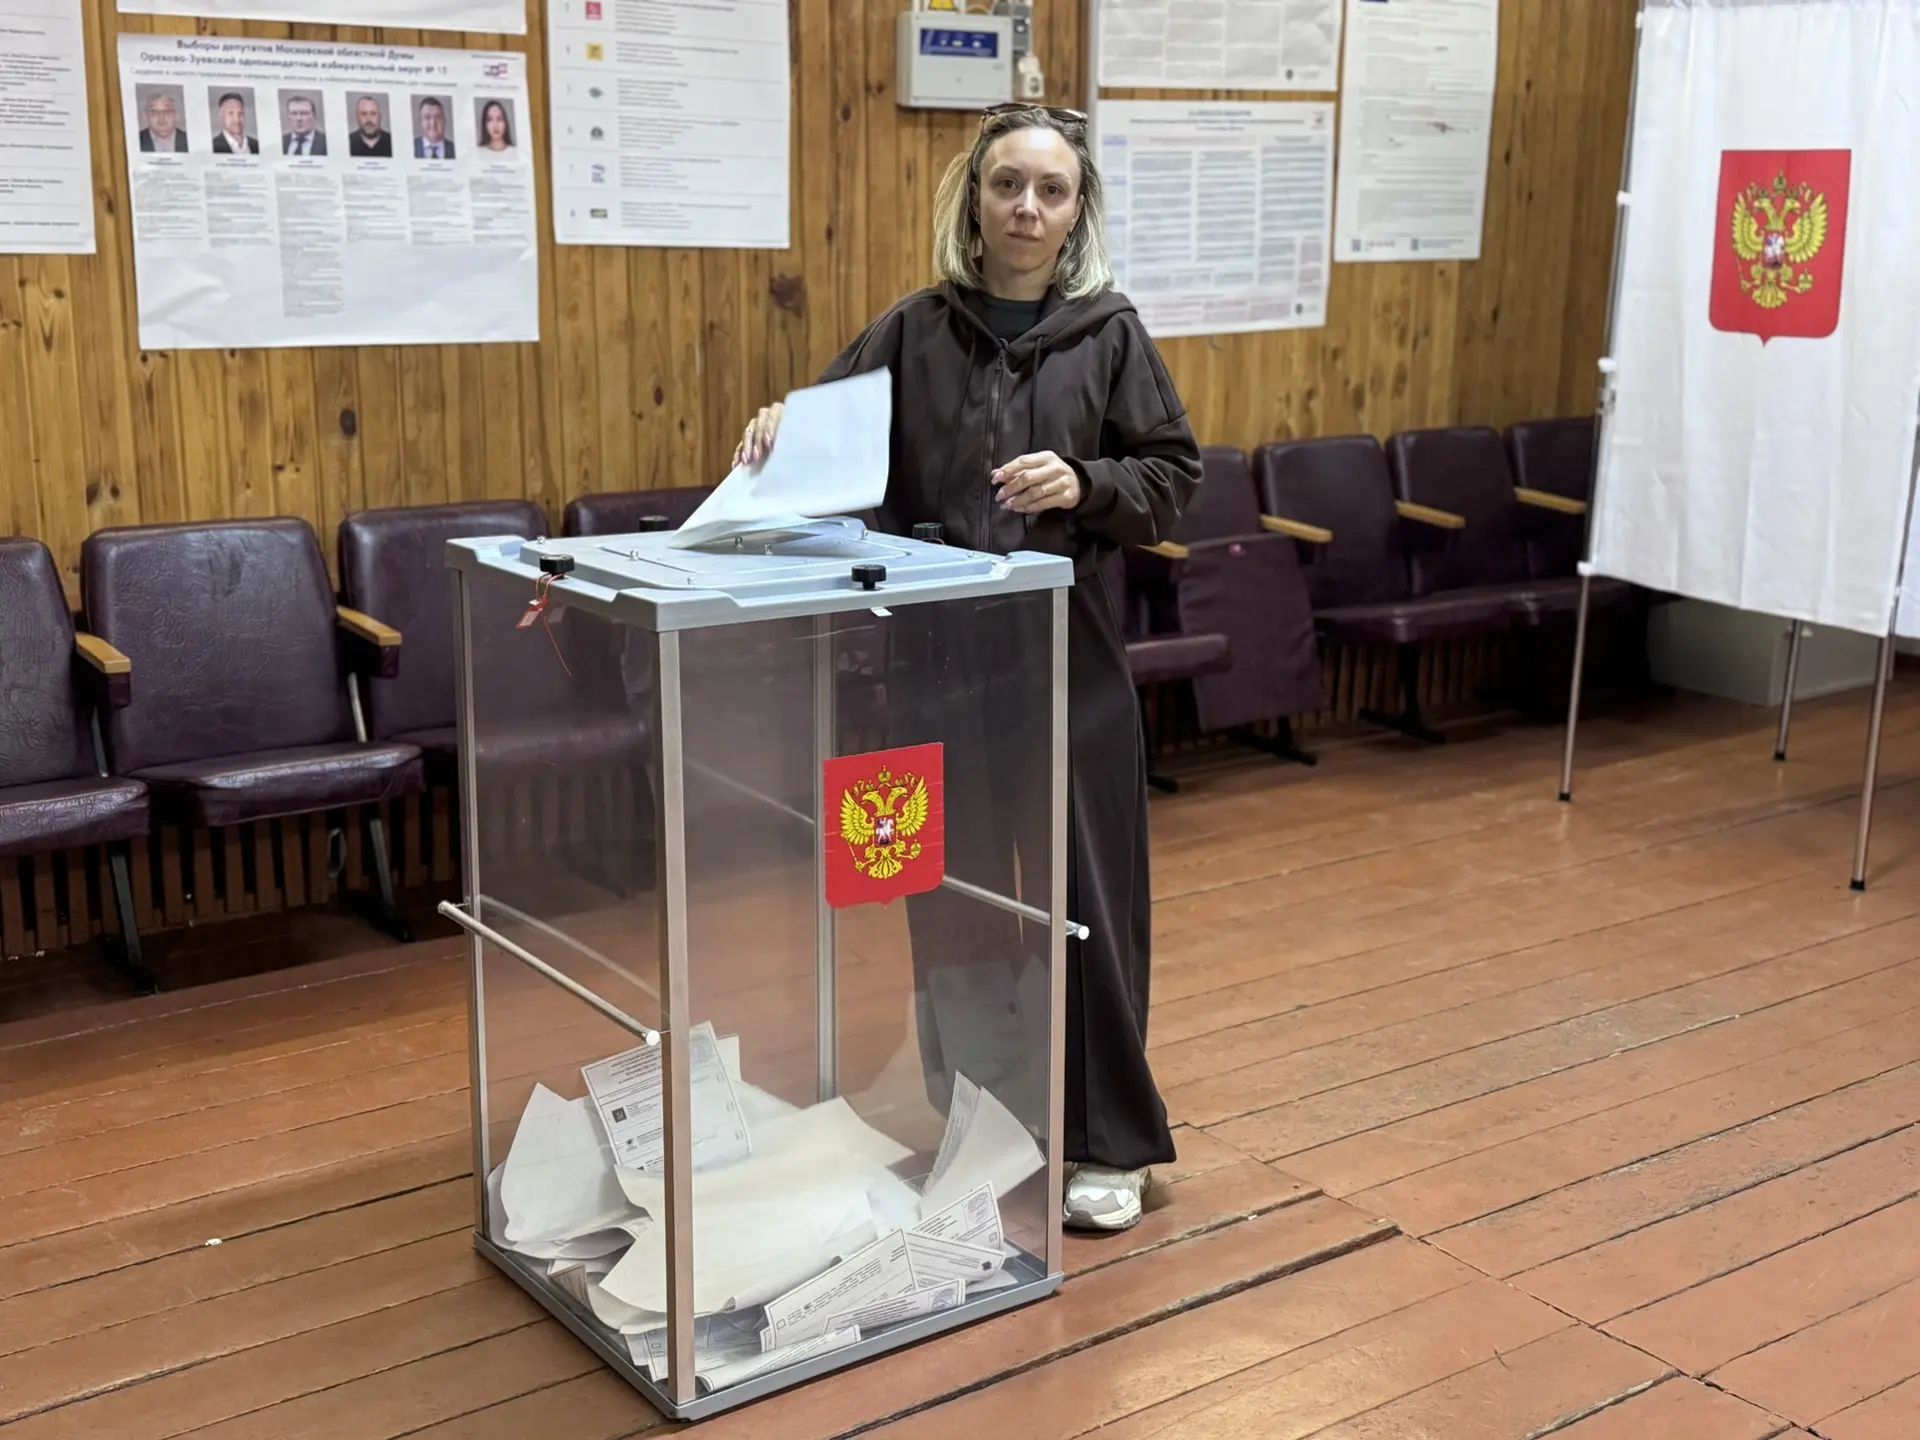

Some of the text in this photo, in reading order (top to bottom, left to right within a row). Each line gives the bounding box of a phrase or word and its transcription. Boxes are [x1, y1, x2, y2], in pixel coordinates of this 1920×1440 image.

[179, 40, 415, 61] Выборы депутатов Московской областной Думы
[140, 52, 236, 66] Орехово-Зуевский
[238, 58, 318, 70] одномандатный
[321, 60, 394, 74] избирательный
